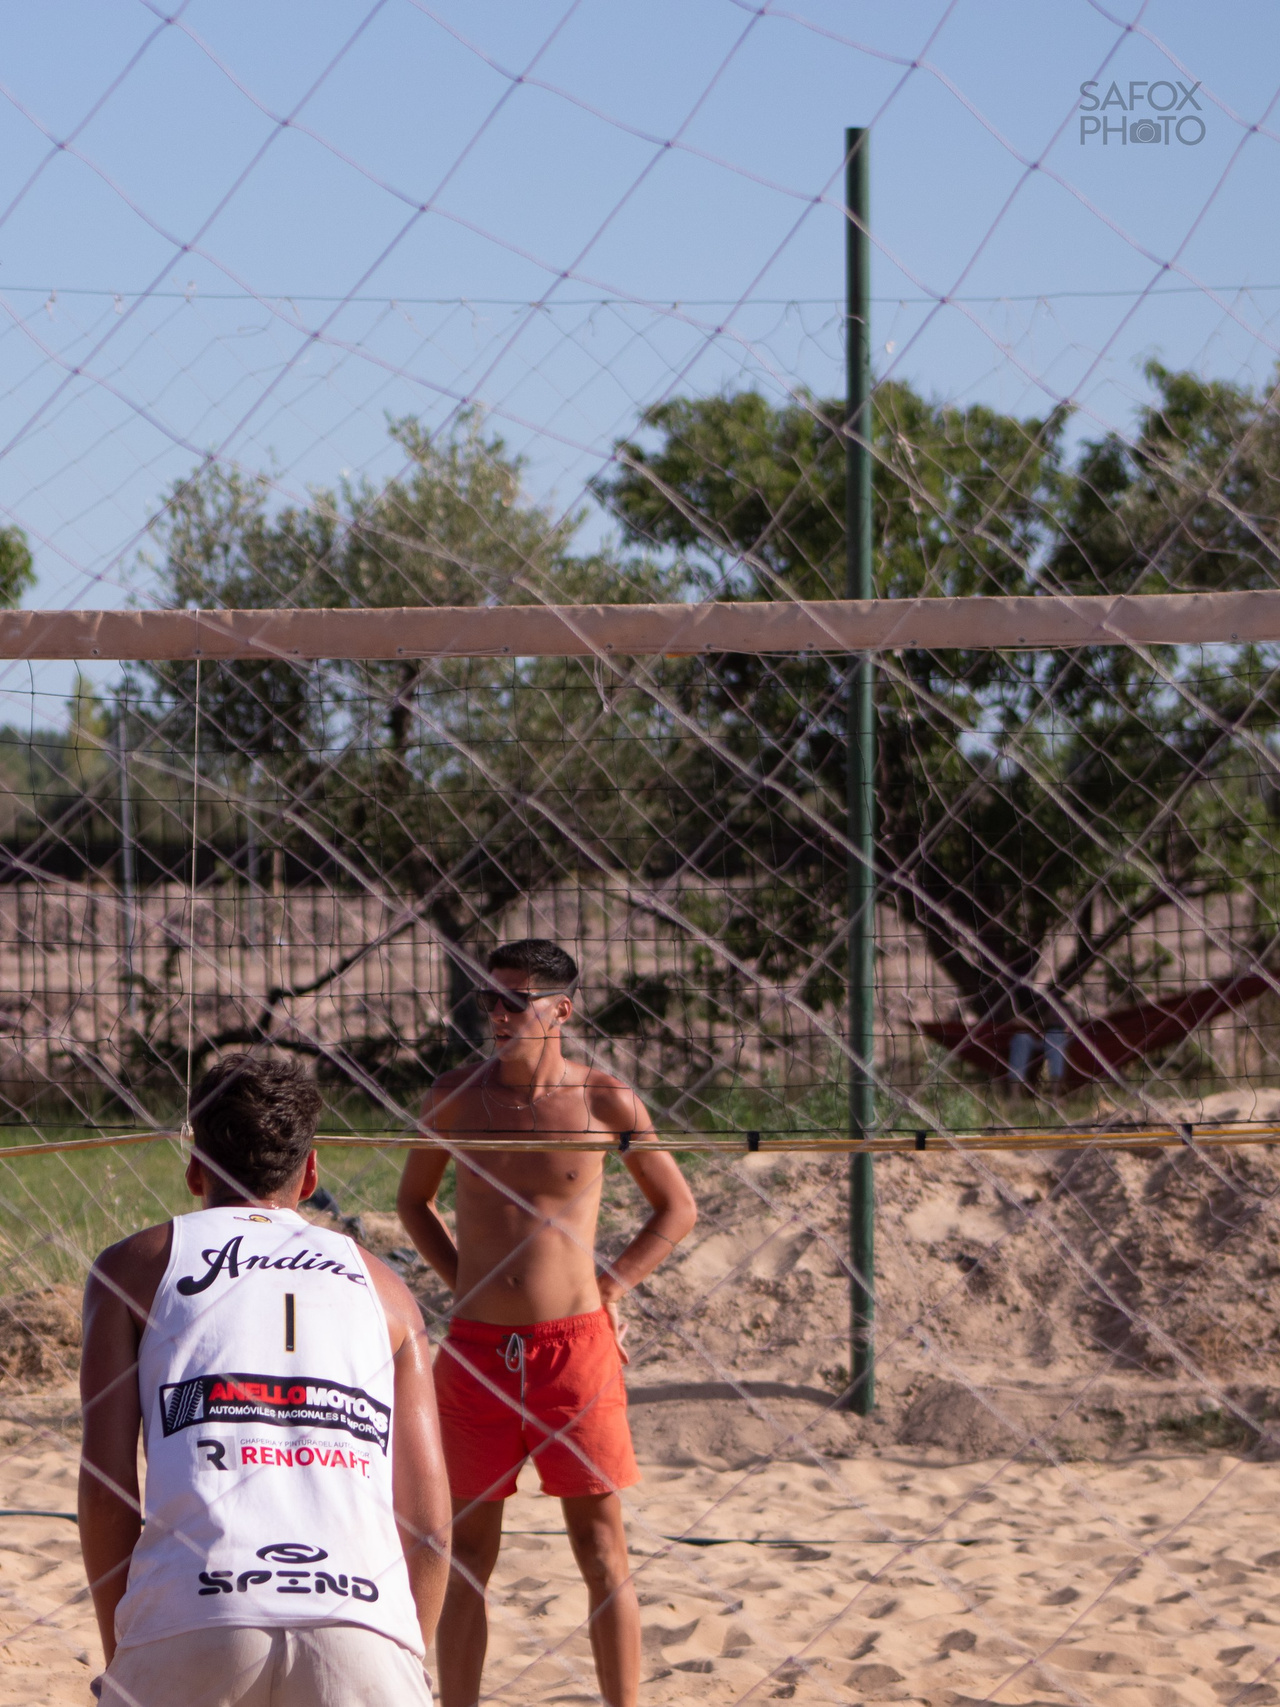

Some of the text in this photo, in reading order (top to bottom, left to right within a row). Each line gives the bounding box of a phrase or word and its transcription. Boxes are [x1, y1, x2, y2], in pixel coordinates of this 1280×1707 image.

[209, 1405, 386, 1448] AUTOMÓVILES NACIONALES E IMPORTS
[284, 1438, 317, 1448] PINTURA
